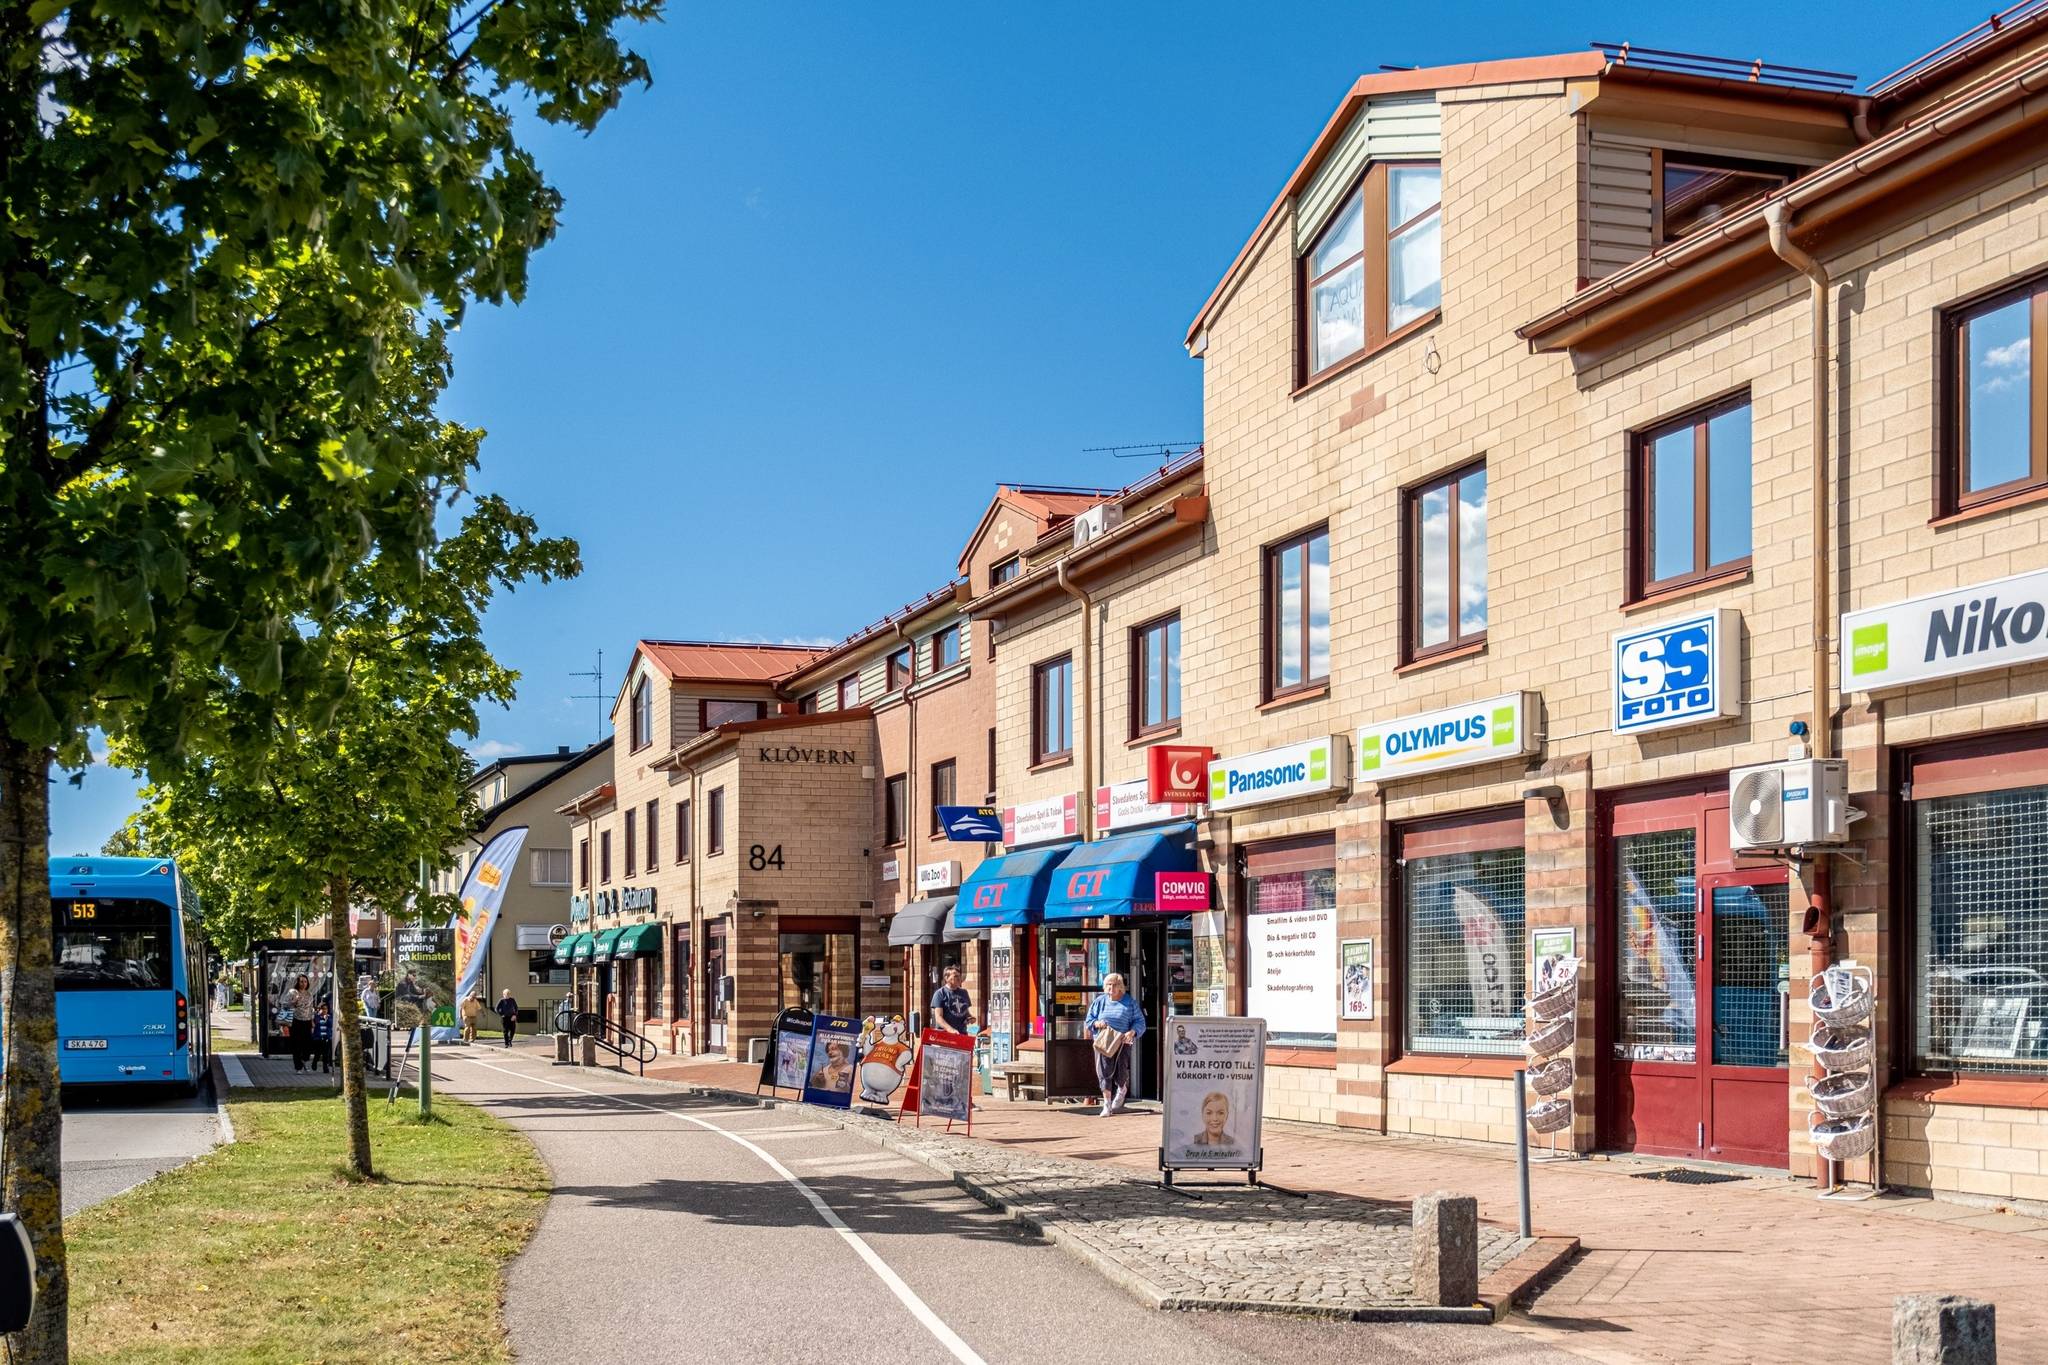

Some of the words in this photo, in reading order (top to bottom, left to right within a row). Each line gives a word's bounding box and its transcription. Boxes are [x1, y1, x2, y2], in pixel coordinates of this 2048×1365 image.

[1924, 596, 2048, 662] Niko
[1622, 625, 1709, 700] SS
[1622, 687, 1709, 721] FOTO
[1386, 714, 1486, 756] OLYMPUS
[760, 746, 856, 764] KLÖVERN
[1229, 762, 1305, 794] Panasonic
[749, 844, 785, 871] 84
[1067, 869, 1111, 899] GT
[1162, 881, 1205, 894] COMVIQ
[973, 883, 1008, 909] GT
[73, 904, 95, 918] 513
[1267, 917, 1287, 925] Smalfilm
[1317, 913, 1328, 921] DVD
[399, 934, 413, 943] Nu
[413, 933, 427, 943] får
[429, 933, 438, 943] vi
[1281, 933, 1300, 942] negativ
[1309, 931, 1316, 939] CD
[399, 943, 436, 954] ordning
[1275, 950, 1283, 958] och
[399, 951, 410, 963] på
[411, 951, 452, 961] klimatet
[1267, 984, 1314, 993] Skadefotografering
[1349, 1001, 1367, 1012] 169:-
[830, 1020, 849, 1028] ATG
[1176, 1060, 1185, 1068] VI
[1188, 1060, 1206, 1069] TAR
[1208, 1060, 1232, 1069] FOTO
[1234, 1061, 1255, 1070] TILL:
[1177, 1071, 1211, 1080] KÖRKORT
[1185, 1150, 1200, 1158] Drop
[1201, 1150, 1206, 1158] in
[1208, 1150, 1213, 1158] 5
